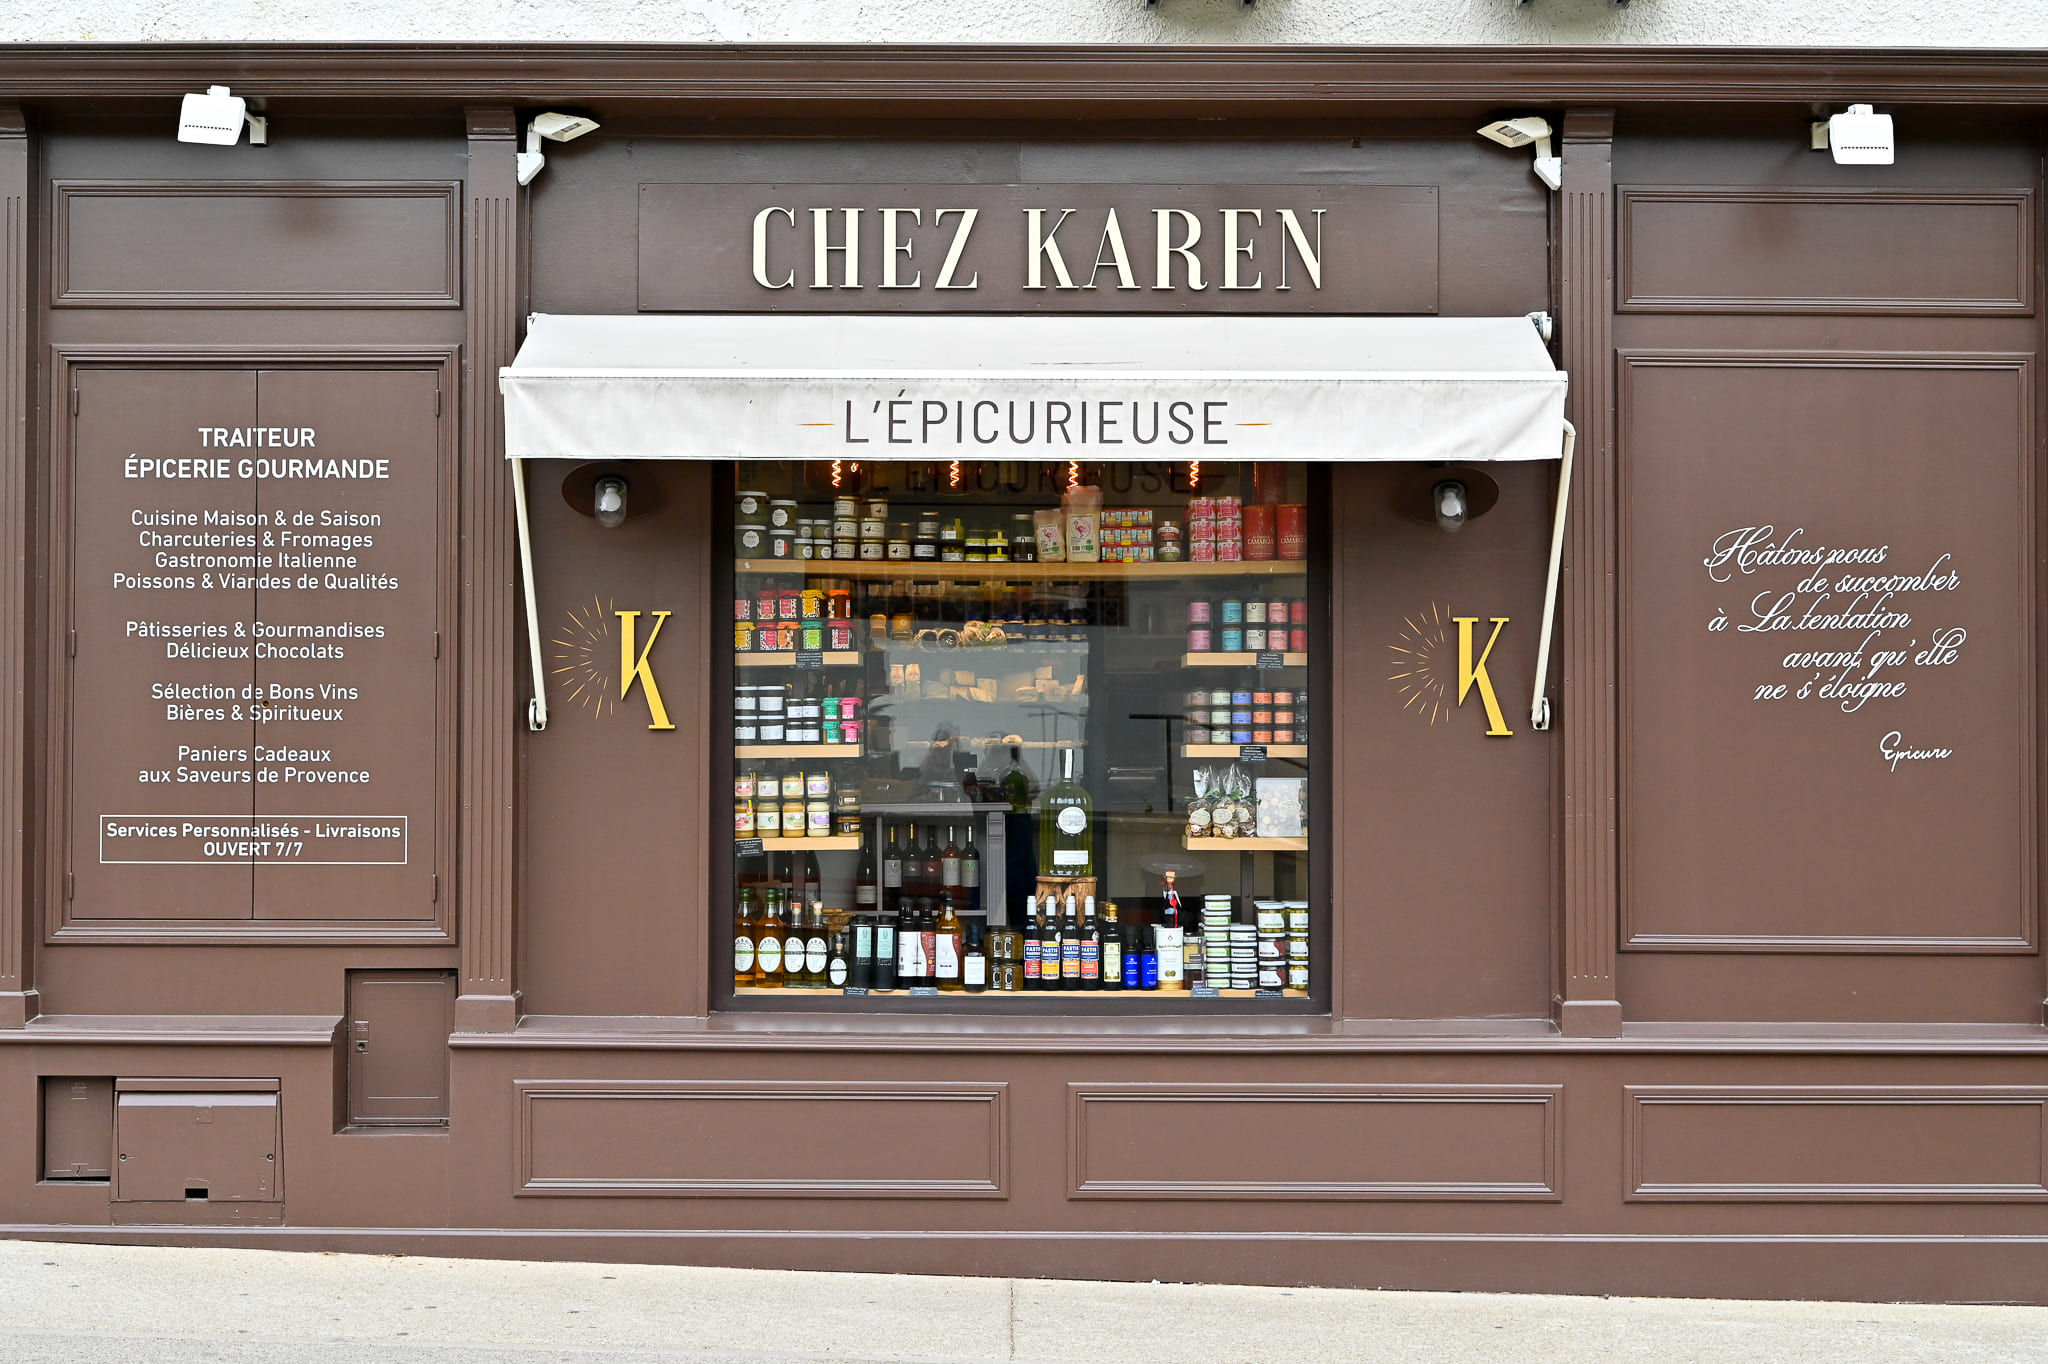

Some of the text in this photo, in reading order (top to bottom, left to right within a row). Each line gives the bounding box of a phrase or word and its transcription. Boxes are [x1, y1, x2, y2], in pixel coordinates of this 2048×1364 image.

[752, 206, 1327, 290] CHEZ KAREN
[846, 389, 1228, 445] L'ÉPICURIEUSE
[197, 427, 316, 448] TRAITEUR
[124, 453, 390, 479] ÉPICERIE GOURMANDE
[131, 509, 381, 527] Cuisine Maison & de Saison
[139, 530, 373, 550] Charcuteries & Fromages
[155, 551, 357, 569] Gastronomie Italienne
[1704, 525, 1888, 582] Hâtons nous
[113, 572, 399, 590] Poissons & Viandes de Qualités
[1797, 553, 1960, 593] de succomber
[1708, 591, 1911, 632] à La tentation
[126, 620, 385, 638] Pâtisseries & Gourmandises
[166, 641, 344, 659] Délicieux Chocolats
[1783, 630, 1880, 669] avant
[615, 610, 676, 729] K
[1453, 617, 1513, 736] K
[151, 682, 359, 700] Sélection de Bons Vins
[1754, 681, 1788, 701] ne
[166, 703, 344, 725] Bières & Spiritueux
[178, 745, 332, 762] Paniers Cadeaux
[1880, 731, 1952, 773] Epicure
[138, 766, 370, 783] aux Saveurs de Provence
[106, 822, 178, 838] Services
[182, 822, 300, 838] Personnalisés
[315, 823, 401, 838] Livraisons
[203, 841, 303, 857] OUVERT 7/7
